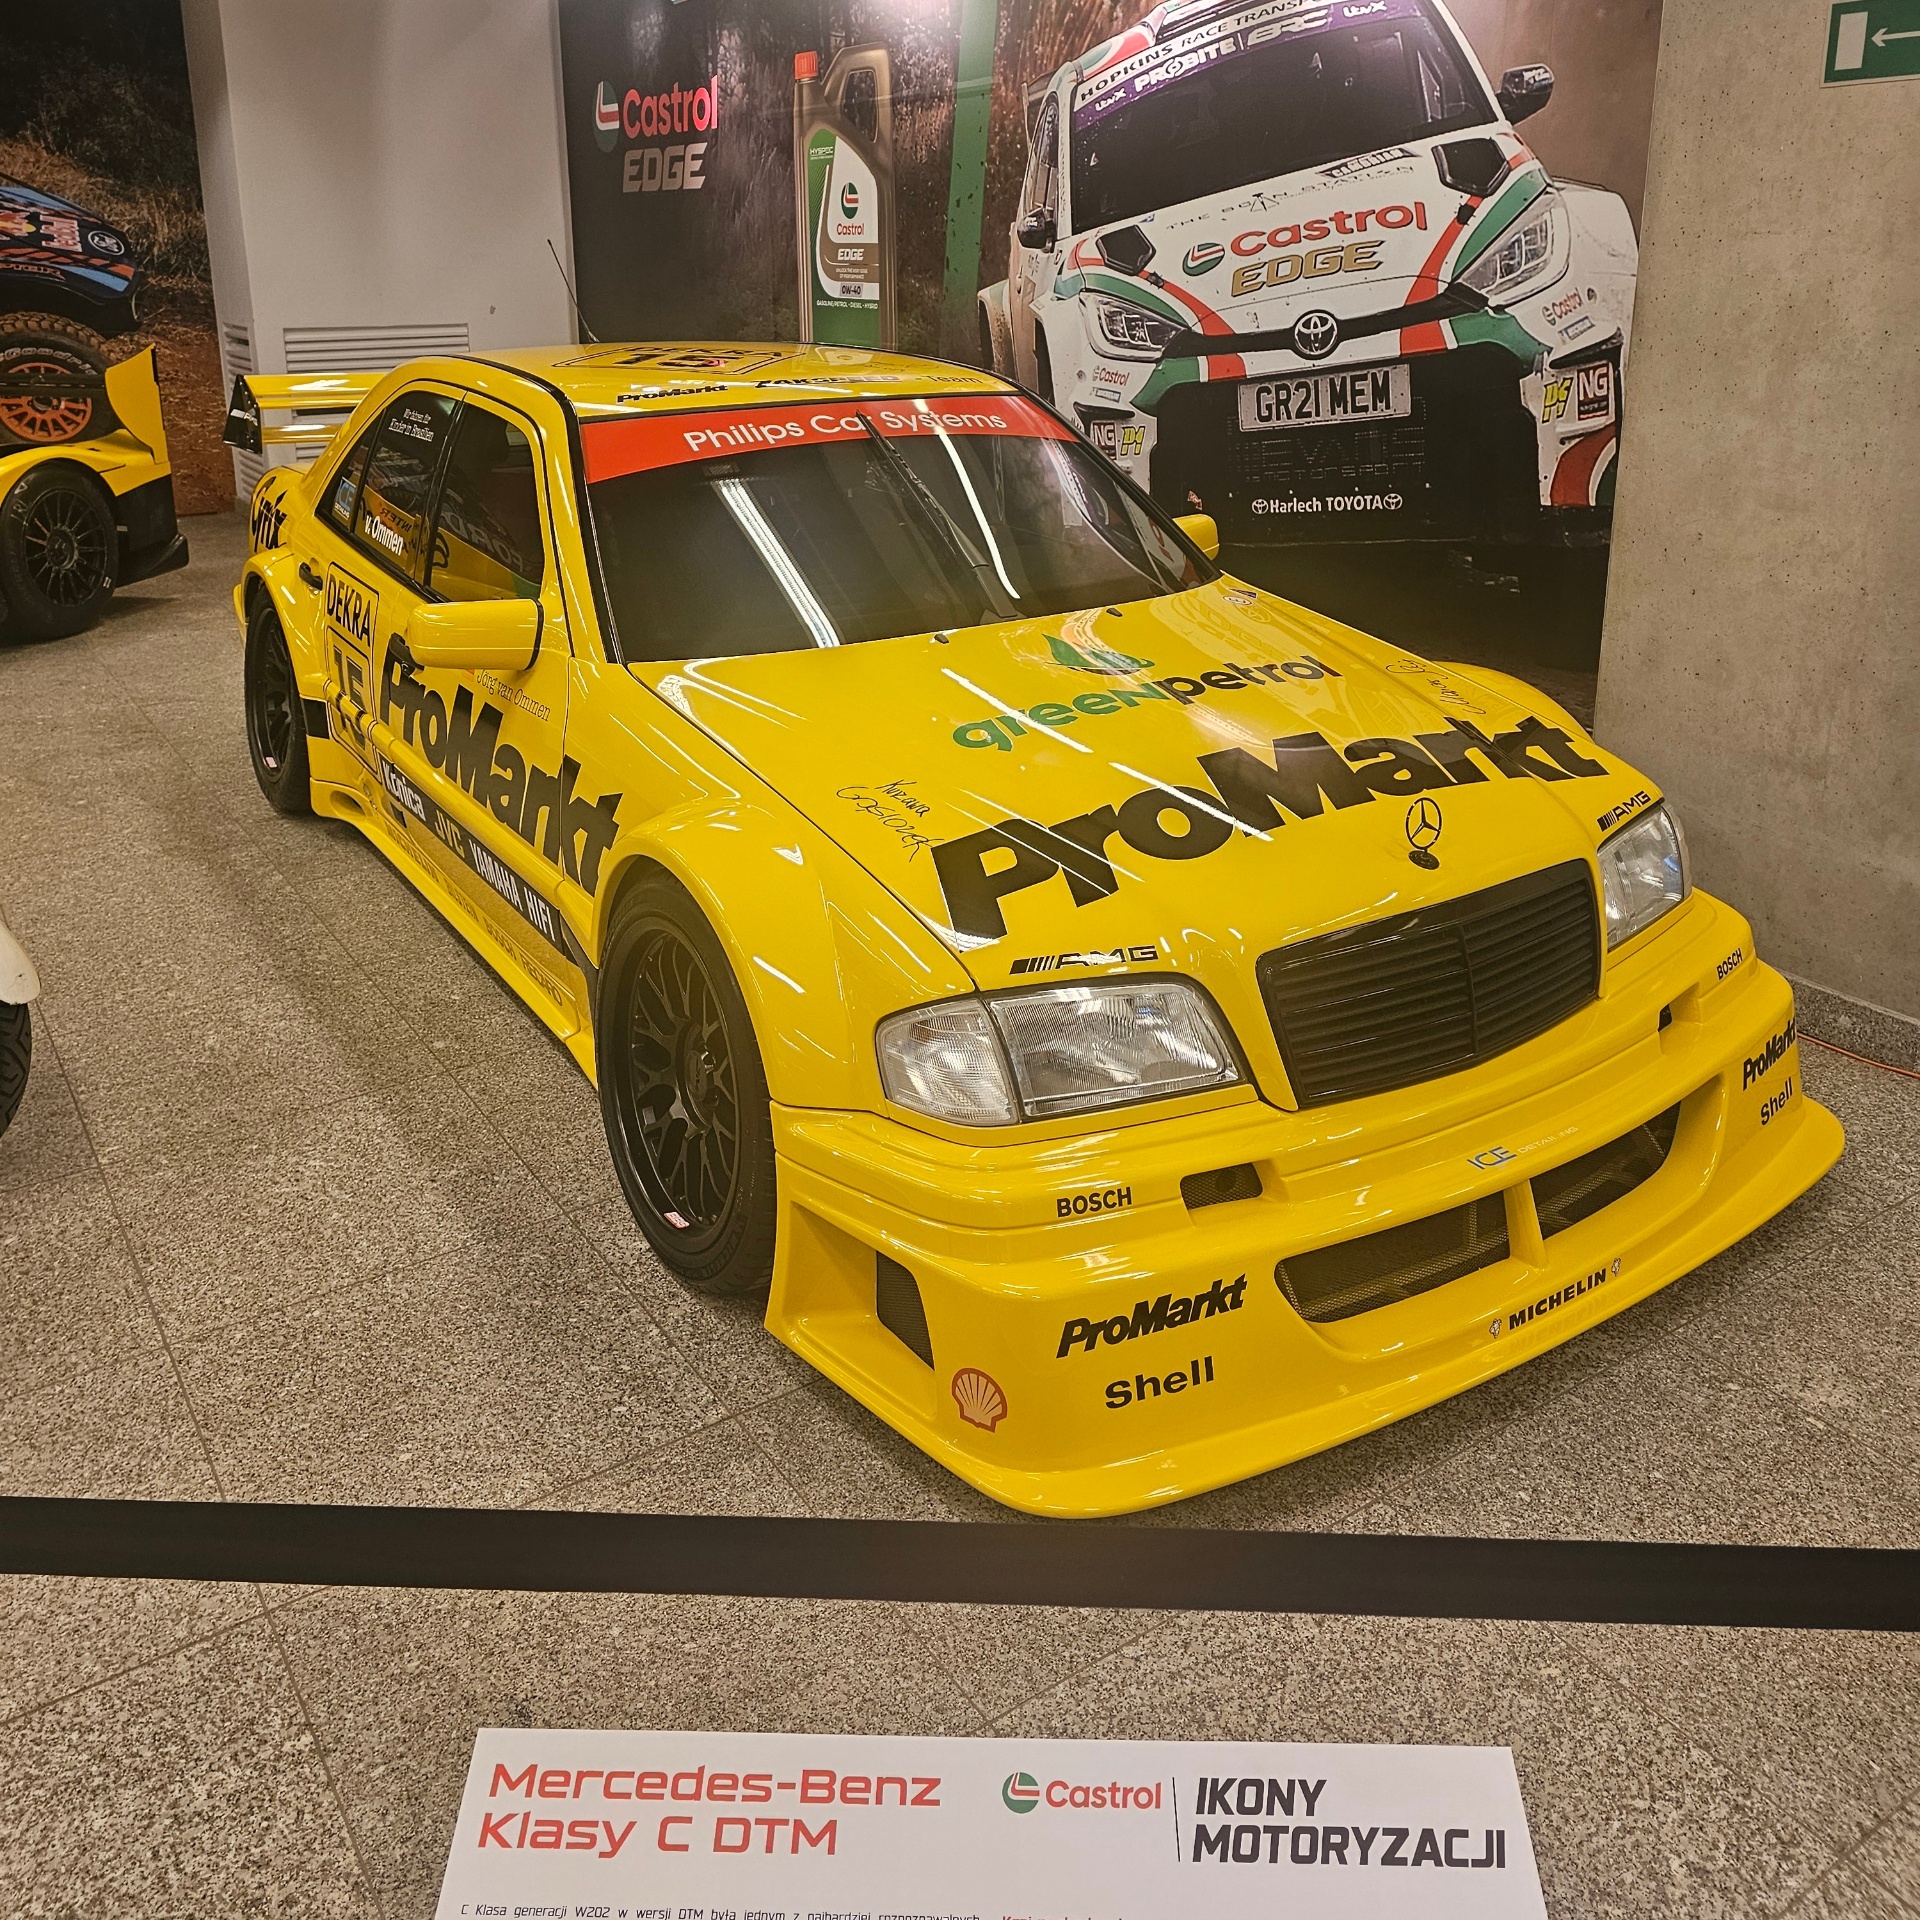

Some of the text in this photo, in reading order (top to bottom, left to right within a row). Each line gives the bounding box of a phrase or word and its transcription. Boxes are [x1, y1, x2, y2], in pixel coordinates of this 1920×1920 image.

[1080, 43, 1174, 102] HOPKINS
[1181, 21, 1229, 47] RACE
[623, 75, 718, 139] Castrol
[623, 142, 708, 193] EDGE
[836, 223, 865, 236] Castrol
[1230, 201, 1428, 257] Castrol
[837, 248, 865, 261] EDGE
[1231, 240, 1386, 298] EDGE
[841, 285, 861, 296] 0W-40
[616, 384, 728, 403] ProMarkt
[926, 374, 983, 384] Team
[1099, 368, 1130, 387] Castrol
[1255, 369, 1391, 423] GR21 MEM
[1579, 367, 1608, 401] NG
[683, 406, 805, 453] Philips
[879, 409, 1007, 433] Systems
[1093, 424, 1116, 447] NG
[1269, 495, 1383, 513] Harlech TOYOTA
[364, 514, 404, 556] v. Ommen
[327, 574, 371, 647] DEKRA
[476, 668, 551, 722] Jörg van Ommen
[380, 650, 623, 899] ProMarkt
[1613, 790, 1651, 823] AMG
[382, 760, 556, 942] Konica JVC YAMAHA HIFI
[932, 714, 1612, 953] ProMarkt
[518, 951, 564, 1008] RECARO
[1055, 944, 1159, 970] AMG
[1716, 947, 1743, 981] BOSCH
[1760, 1076, 1793, 1127] Shell
[1467, 1146, 1518, 1171] ICE
[1056, 1186, 1133, 1219] BOSCH
[1055, 1273, 1252, 1358] ProMarkt
[1508, 1268, 1608, 1331] MICHELIN
[1104, 1356, 1216, 1410] Shell
[489, 1763, 941, 1807] Mercedes-Benz
[1045, 1779, 1162, 1810] Castrol
[1194, 1777, 1327, 1817] IKONY
[478, 1810, 838, 1859] Klasy C DTM
[1192, 1823, 1506, 1869] MOTORYZACJI
[461, 1904, 470, 1915] C
[475, 1904, 507, 1916] Klasa
[513, 1905, 568, 1919] generacji
[575, 1906, 611, 1918] W202
[617, 1909, 628, 1918] w
[635, 1907, 671, 1920] wersji
[678, 1908, 704, 1919] DTM
[710, 1908, 737, 1920] była
[744, 1909, 786, 1920] jednym
